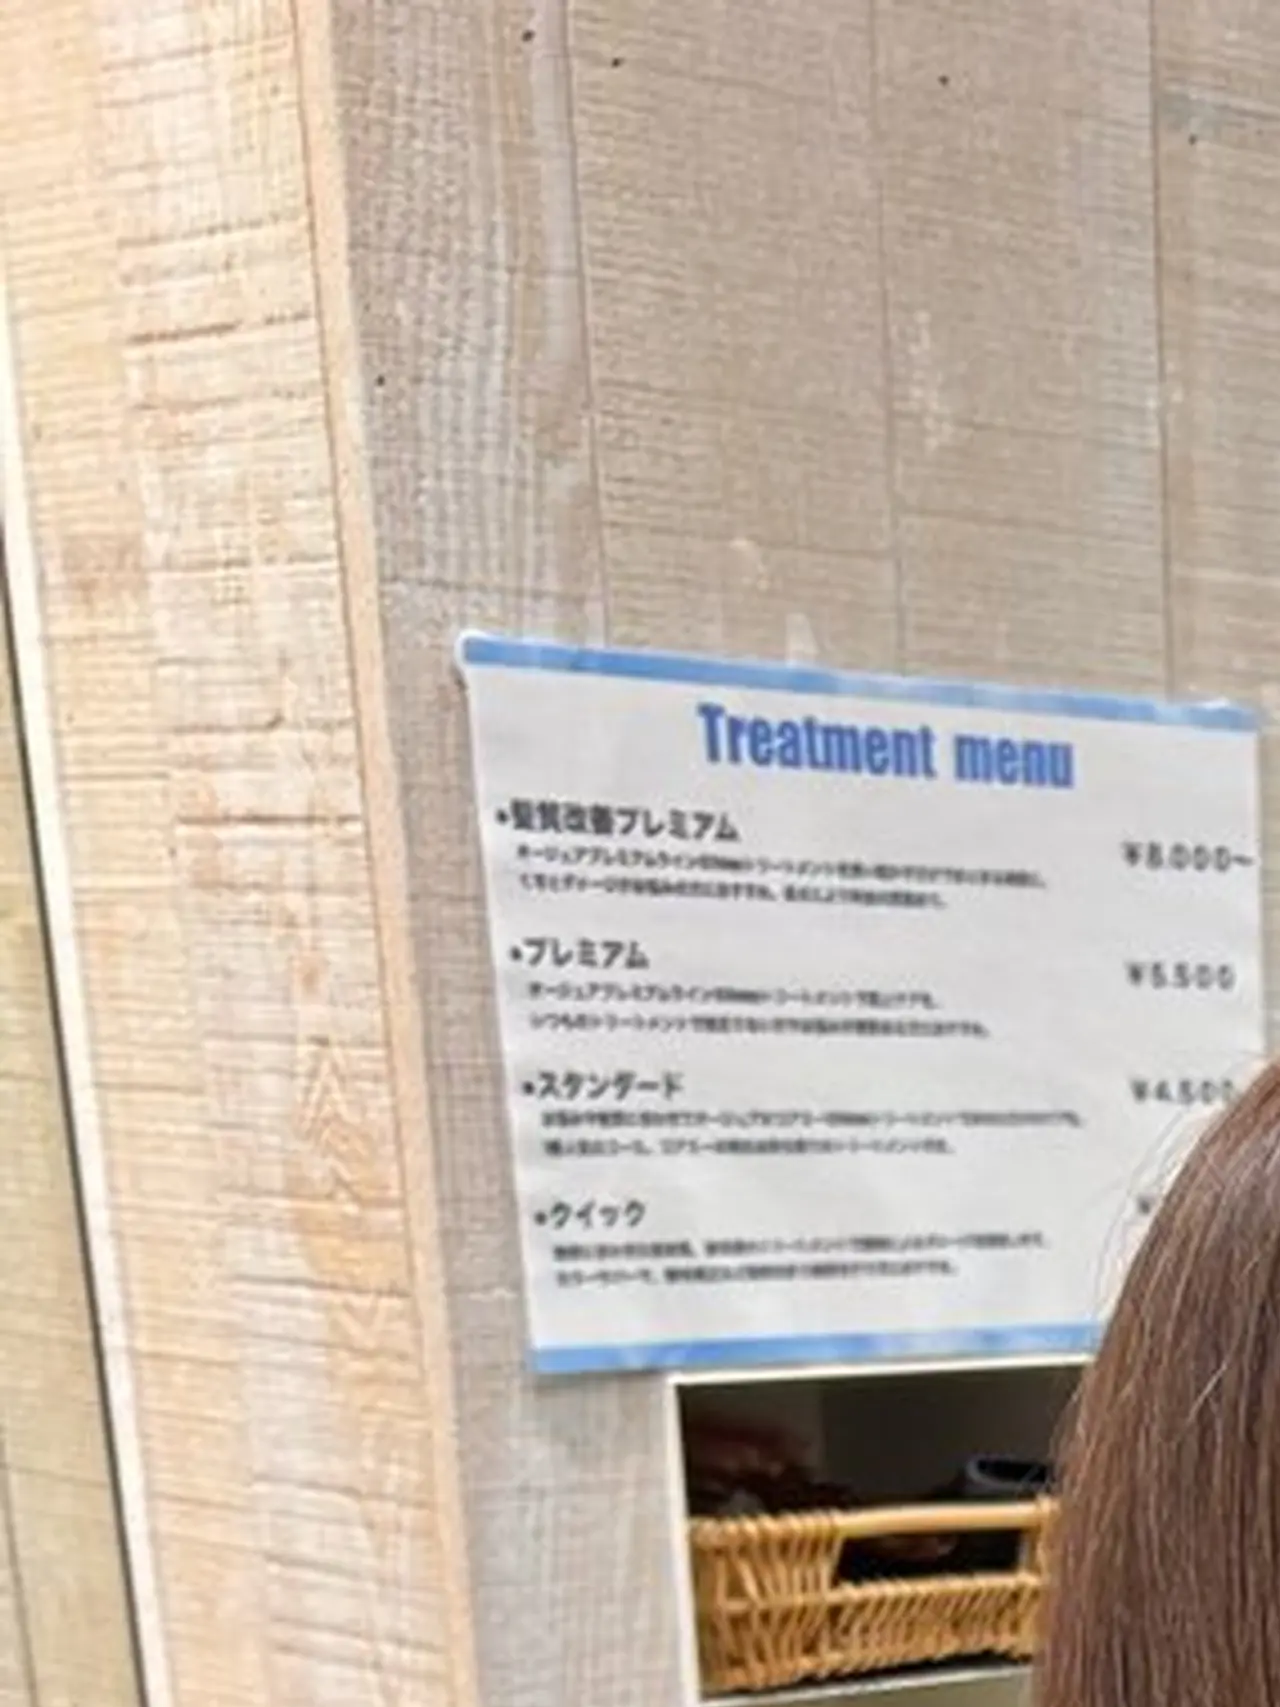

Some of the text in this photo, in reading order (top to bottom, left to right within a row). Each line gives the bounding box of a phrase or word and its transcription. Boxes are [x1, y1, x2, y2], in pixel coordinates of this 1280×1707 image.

[697, 702, 1076, 788] Treatment menu
[522, 936, 651, 970] プレミアム
[537, 1069, 685, 1101] スタンダード
[550, 1199, 646, 1231] クイック
